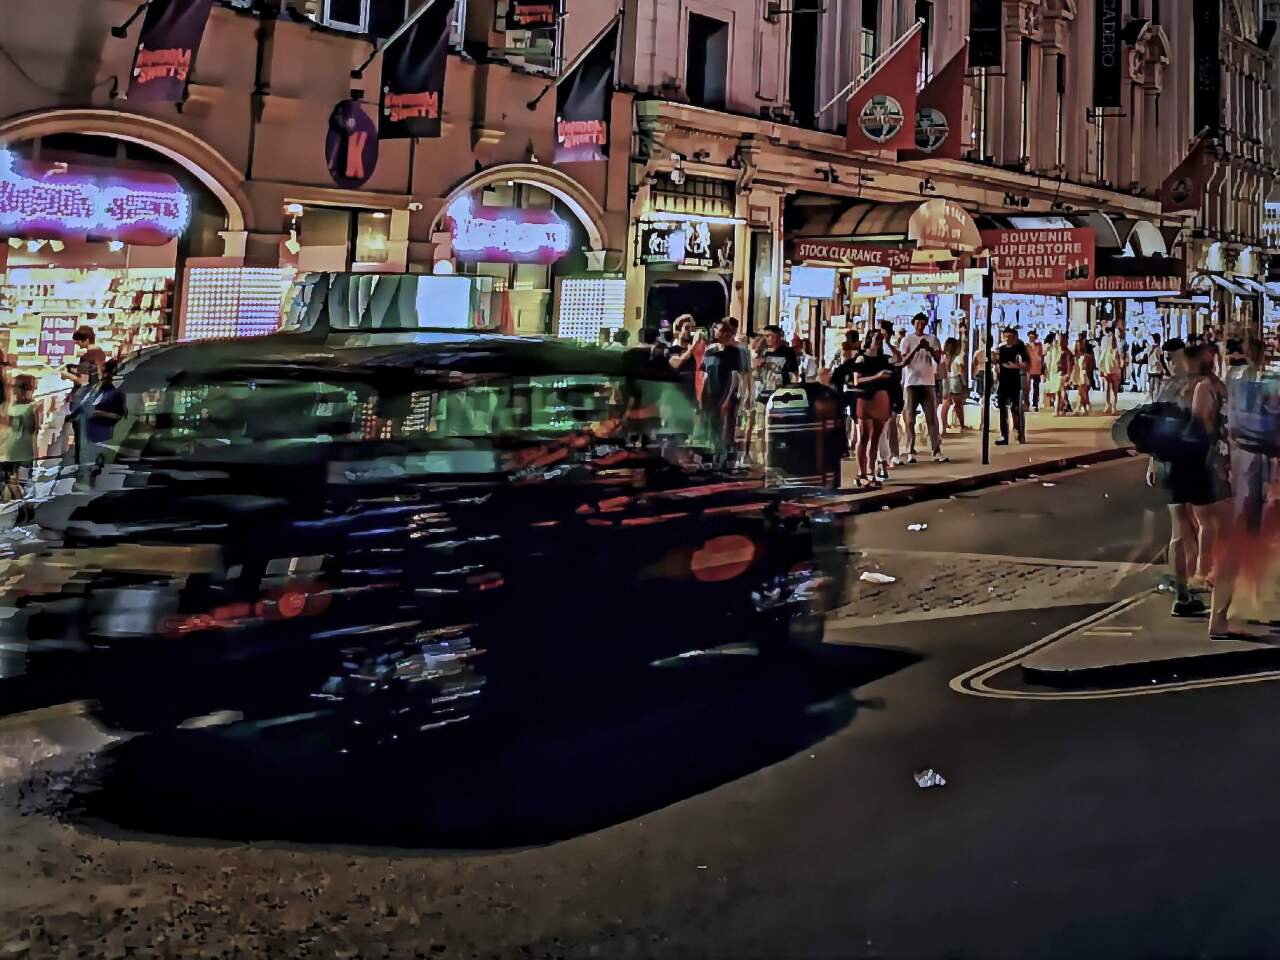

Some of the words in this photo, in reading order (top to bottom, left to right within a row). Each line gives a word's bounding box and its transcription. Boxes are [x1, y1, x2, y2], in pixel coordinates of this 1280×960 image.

[1001, 231, 1072, 243] SOUVENIR
[799, 244, 829, 258] STOCK
[831, 246, 883, 264] CLEARANCE
[992, 243, 1082, 255] SUPERSTORE
[1005, 255, 1067, 267] MASSIVE
[1018, 267, 1053, 279] SALE
[1095, 276, 1144, 290] Glorious
